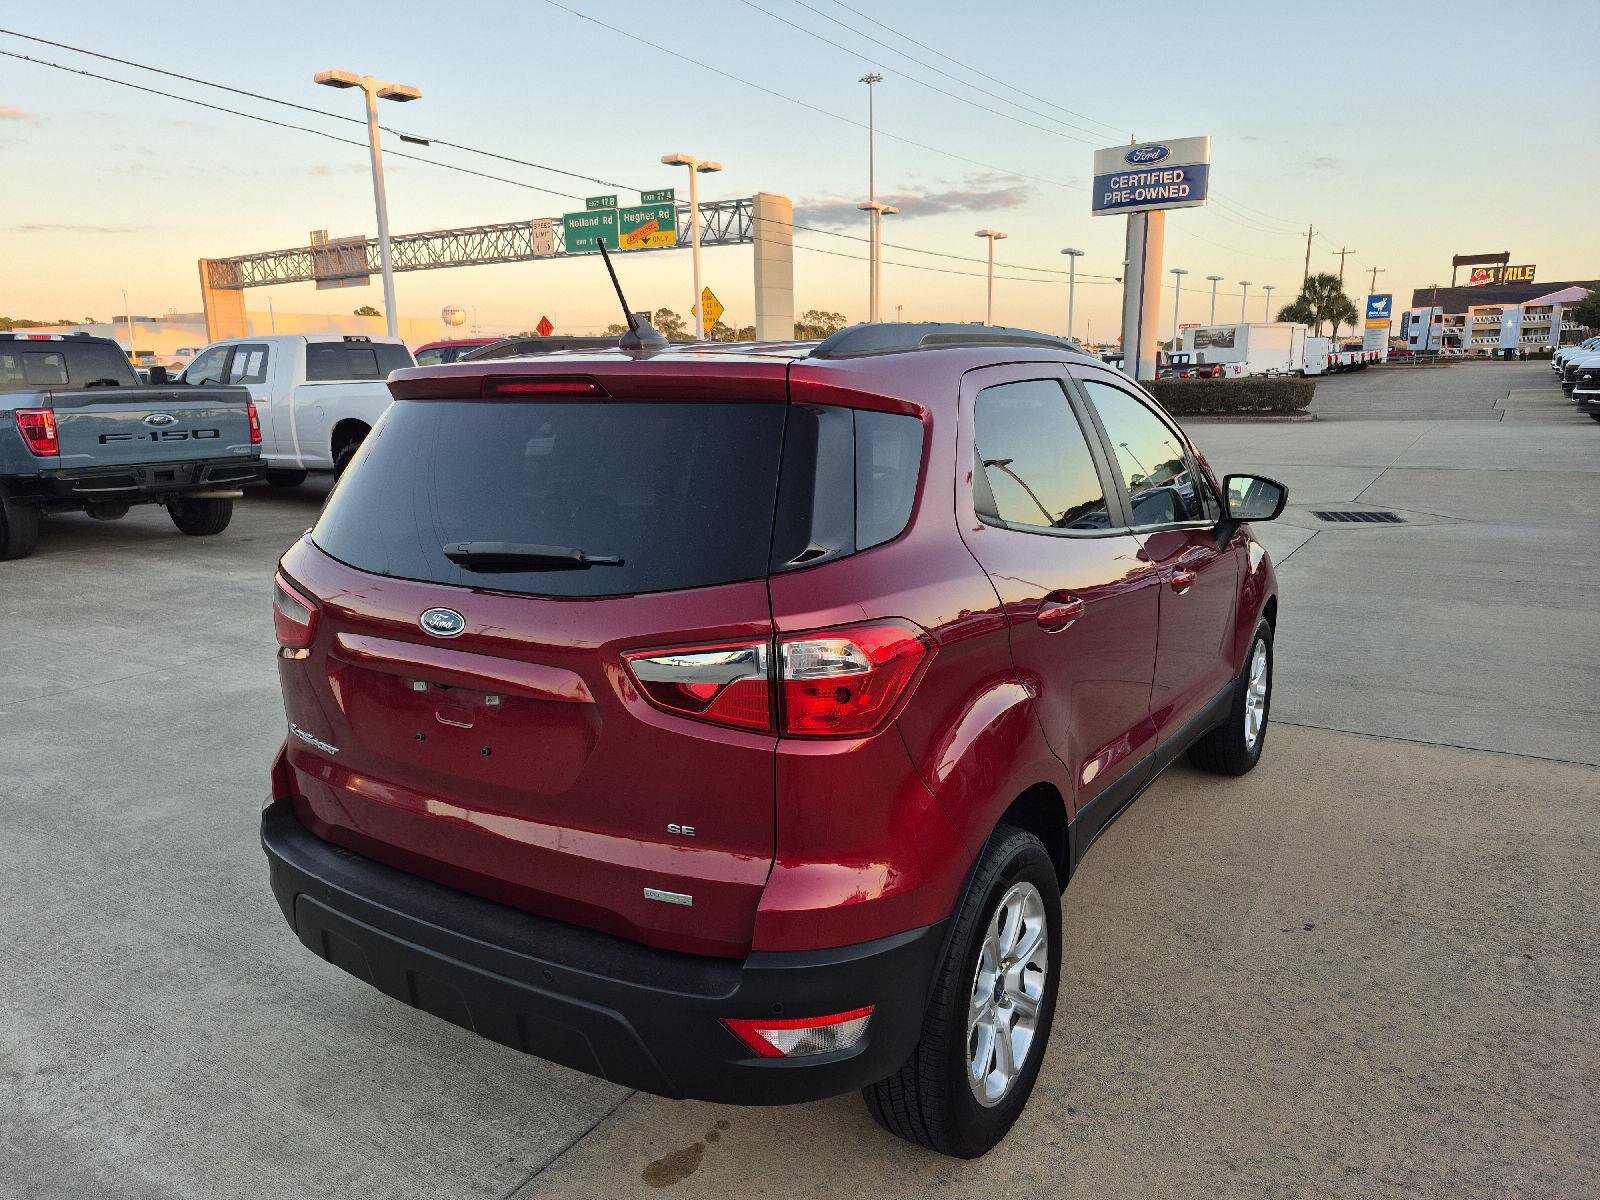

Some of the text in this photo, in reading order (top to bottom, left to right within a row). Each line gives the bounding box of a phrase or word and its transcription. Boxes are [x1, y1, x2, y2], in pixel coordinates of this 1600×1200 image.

[1133, 147, 1161, 161] Ford
[1110, 169, 1185, 190] CERTIFIED
[1103, 184, 1190, 205] PRE-OWNED
[658, 208, 670, 219] Rd
[569, 216, 613, 228] Holland Rd
[98, 428, 220, 445] F-150
[430, 613, 455, 629] Ford
[666, 823, 696, 837] SE
